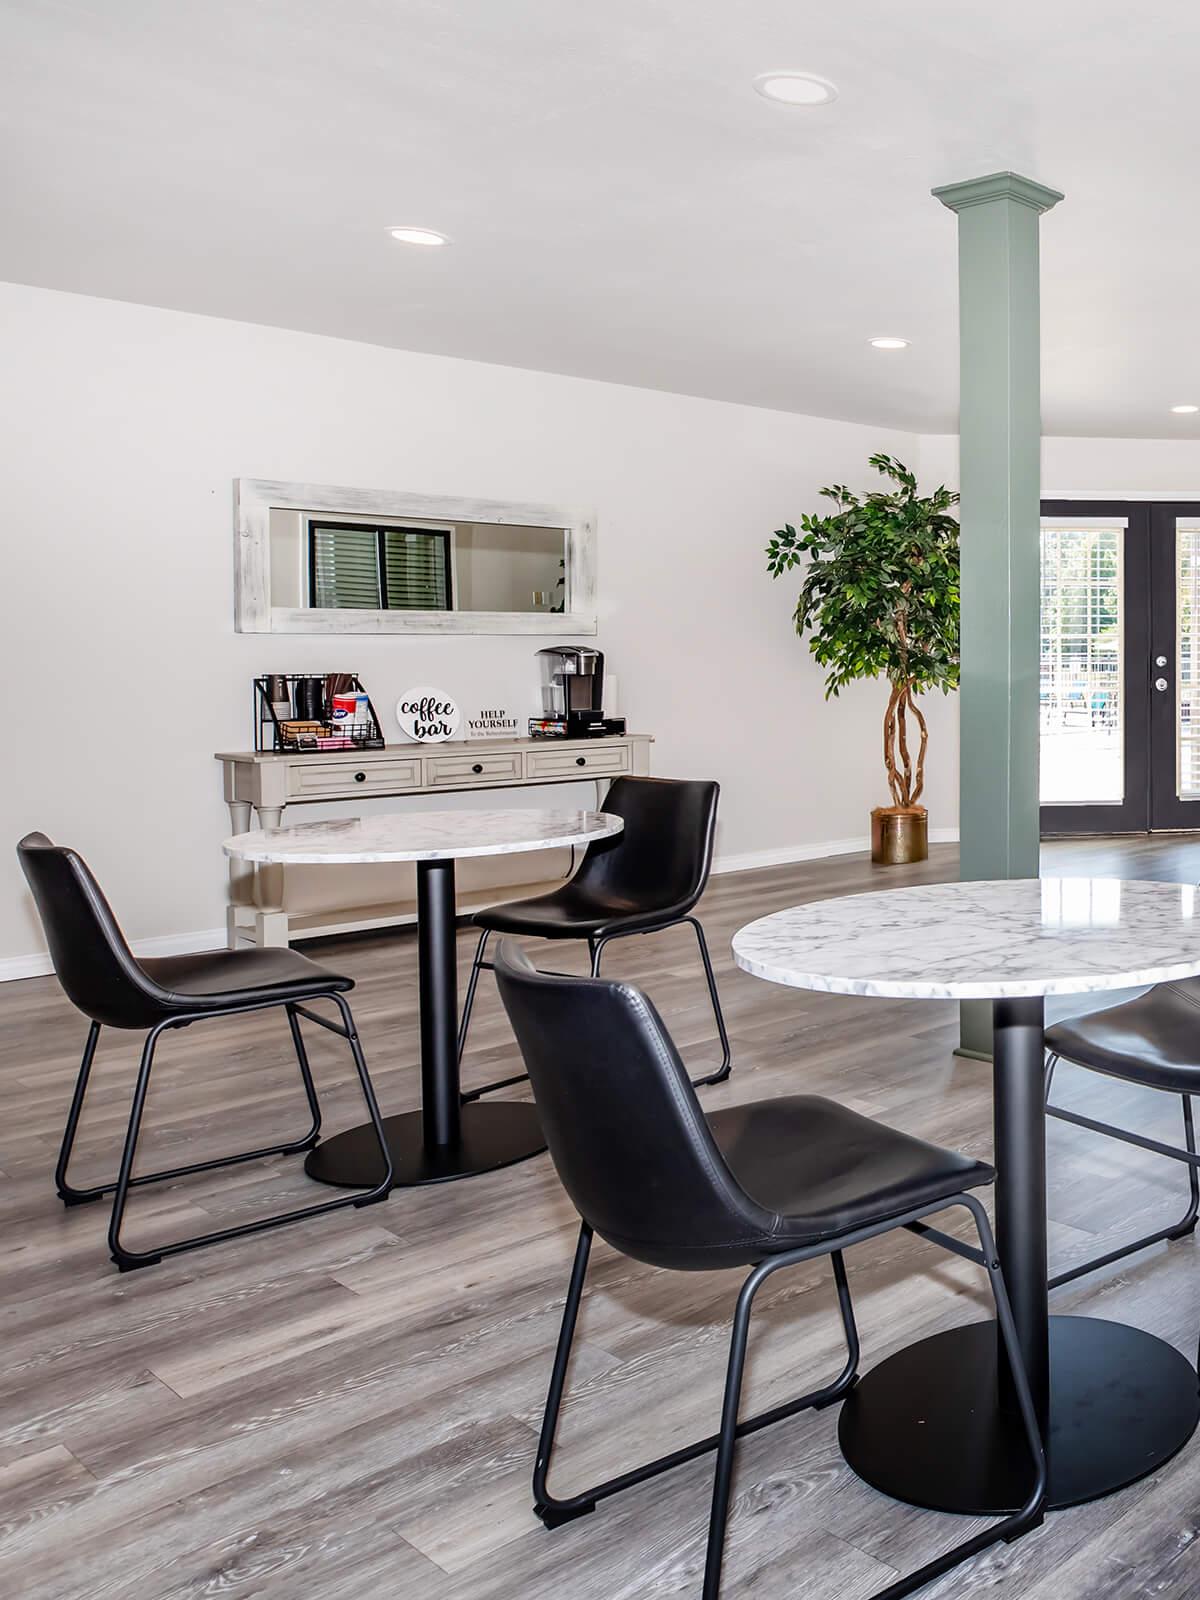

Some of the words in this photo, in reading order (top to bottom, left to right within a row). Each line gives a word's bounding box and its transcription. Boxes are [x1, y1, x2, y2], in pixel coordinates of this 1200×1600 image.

[401, 697, 454, 721] coffee
[480, 710, 505, 719] HELP
[414, 720, 452, 738] bar
[468, 719, 518, 728] YOURSELF
